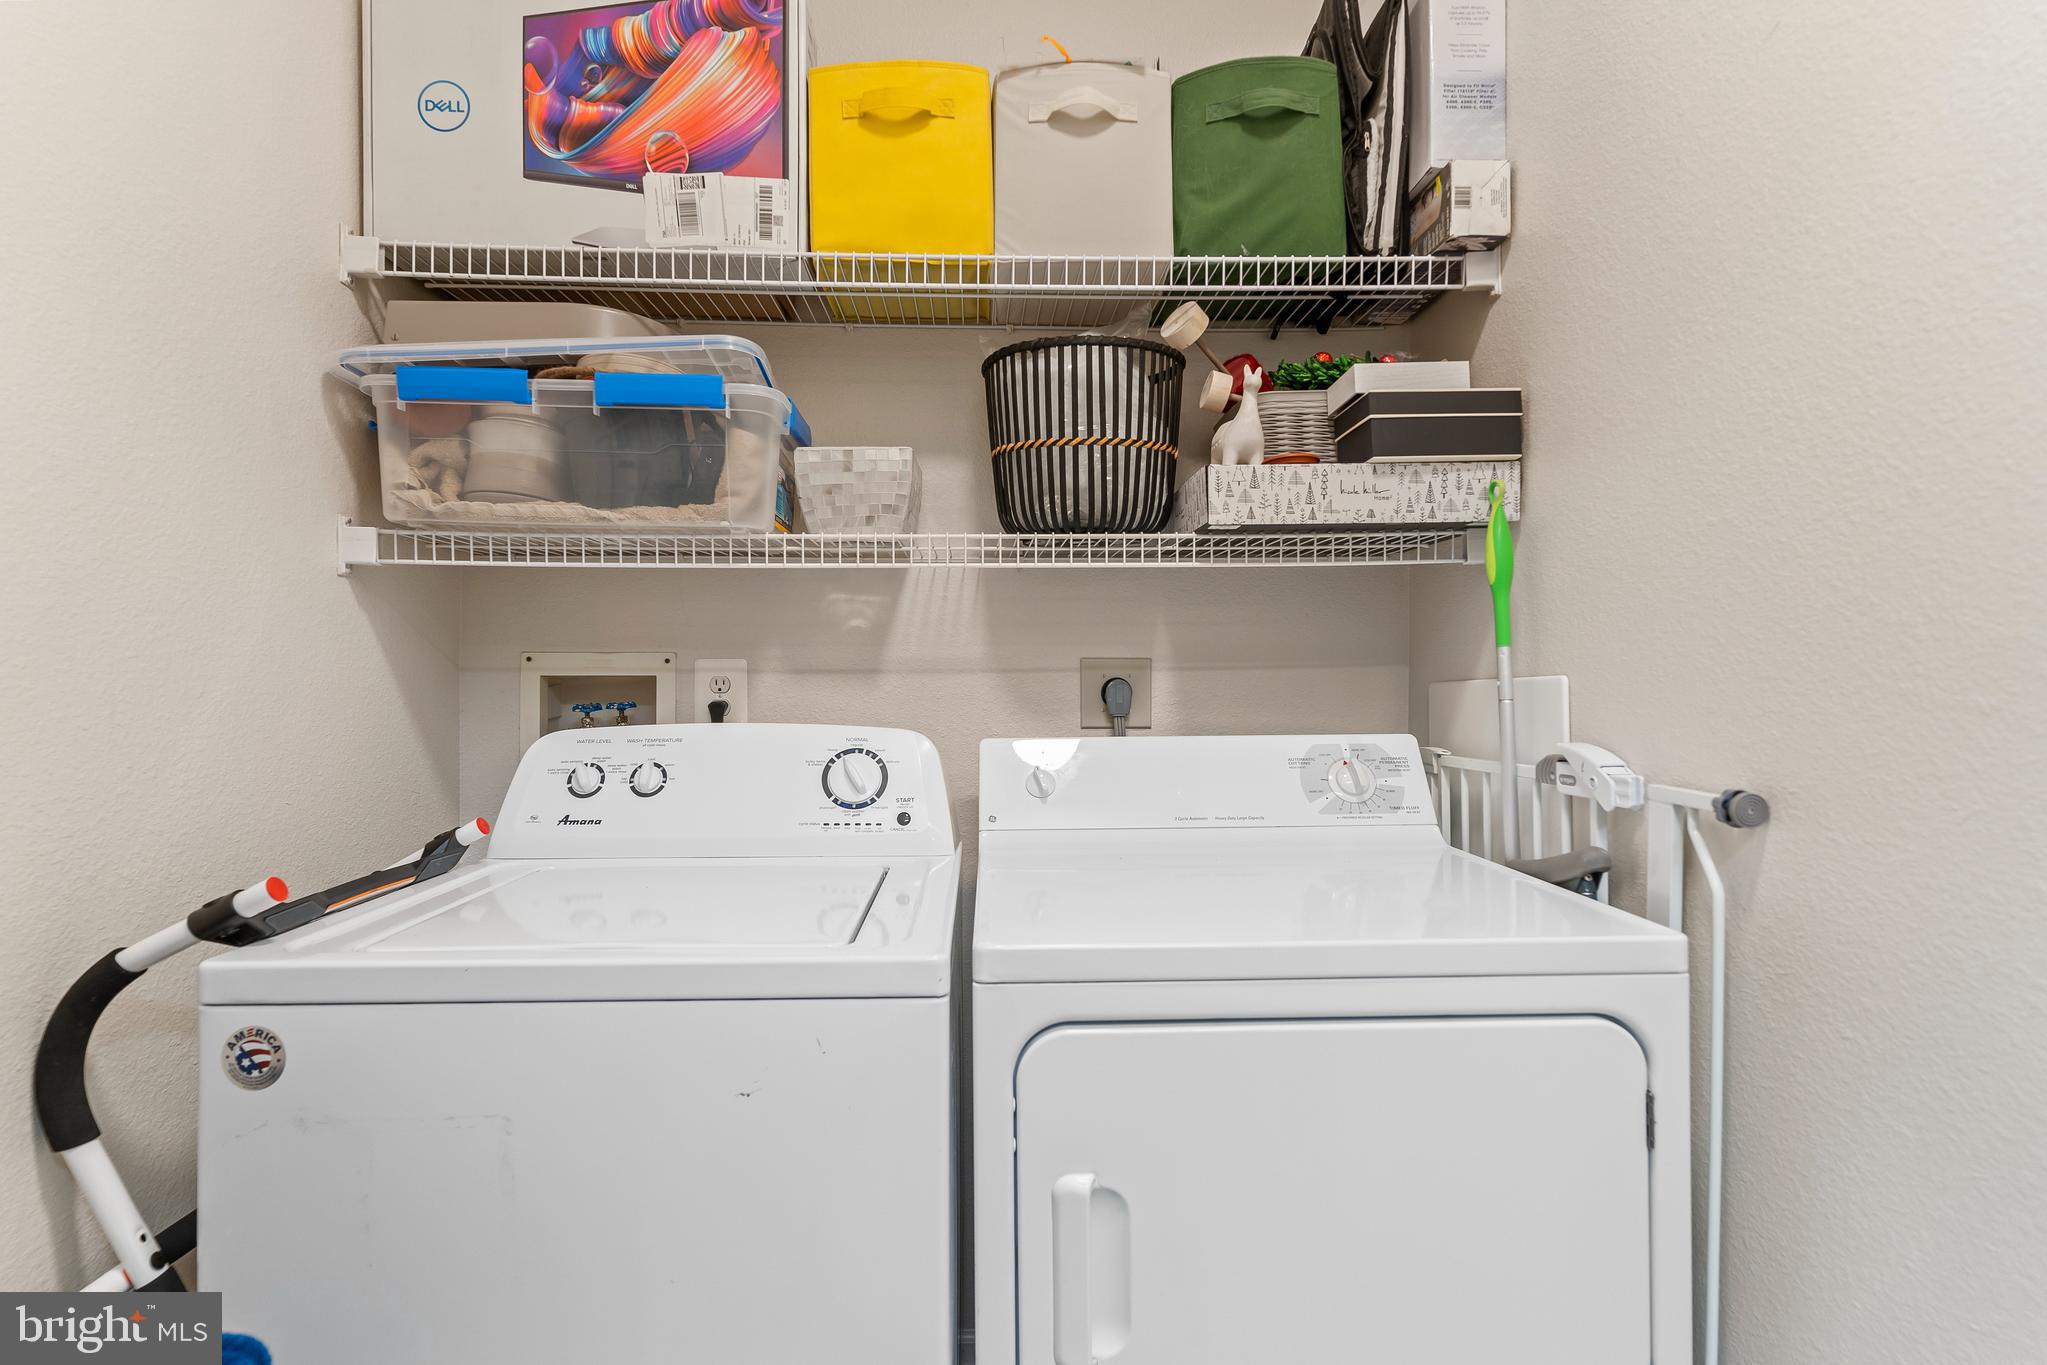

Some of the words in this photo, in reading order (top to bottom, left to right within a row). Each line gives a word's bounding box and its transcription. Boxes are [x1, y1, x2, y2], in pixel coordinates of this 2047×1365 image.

[425, 99, 465, 113] DELL
[557, 814, 603, 826] Amana
[227, 1025, 282, 1054] AMERICA
